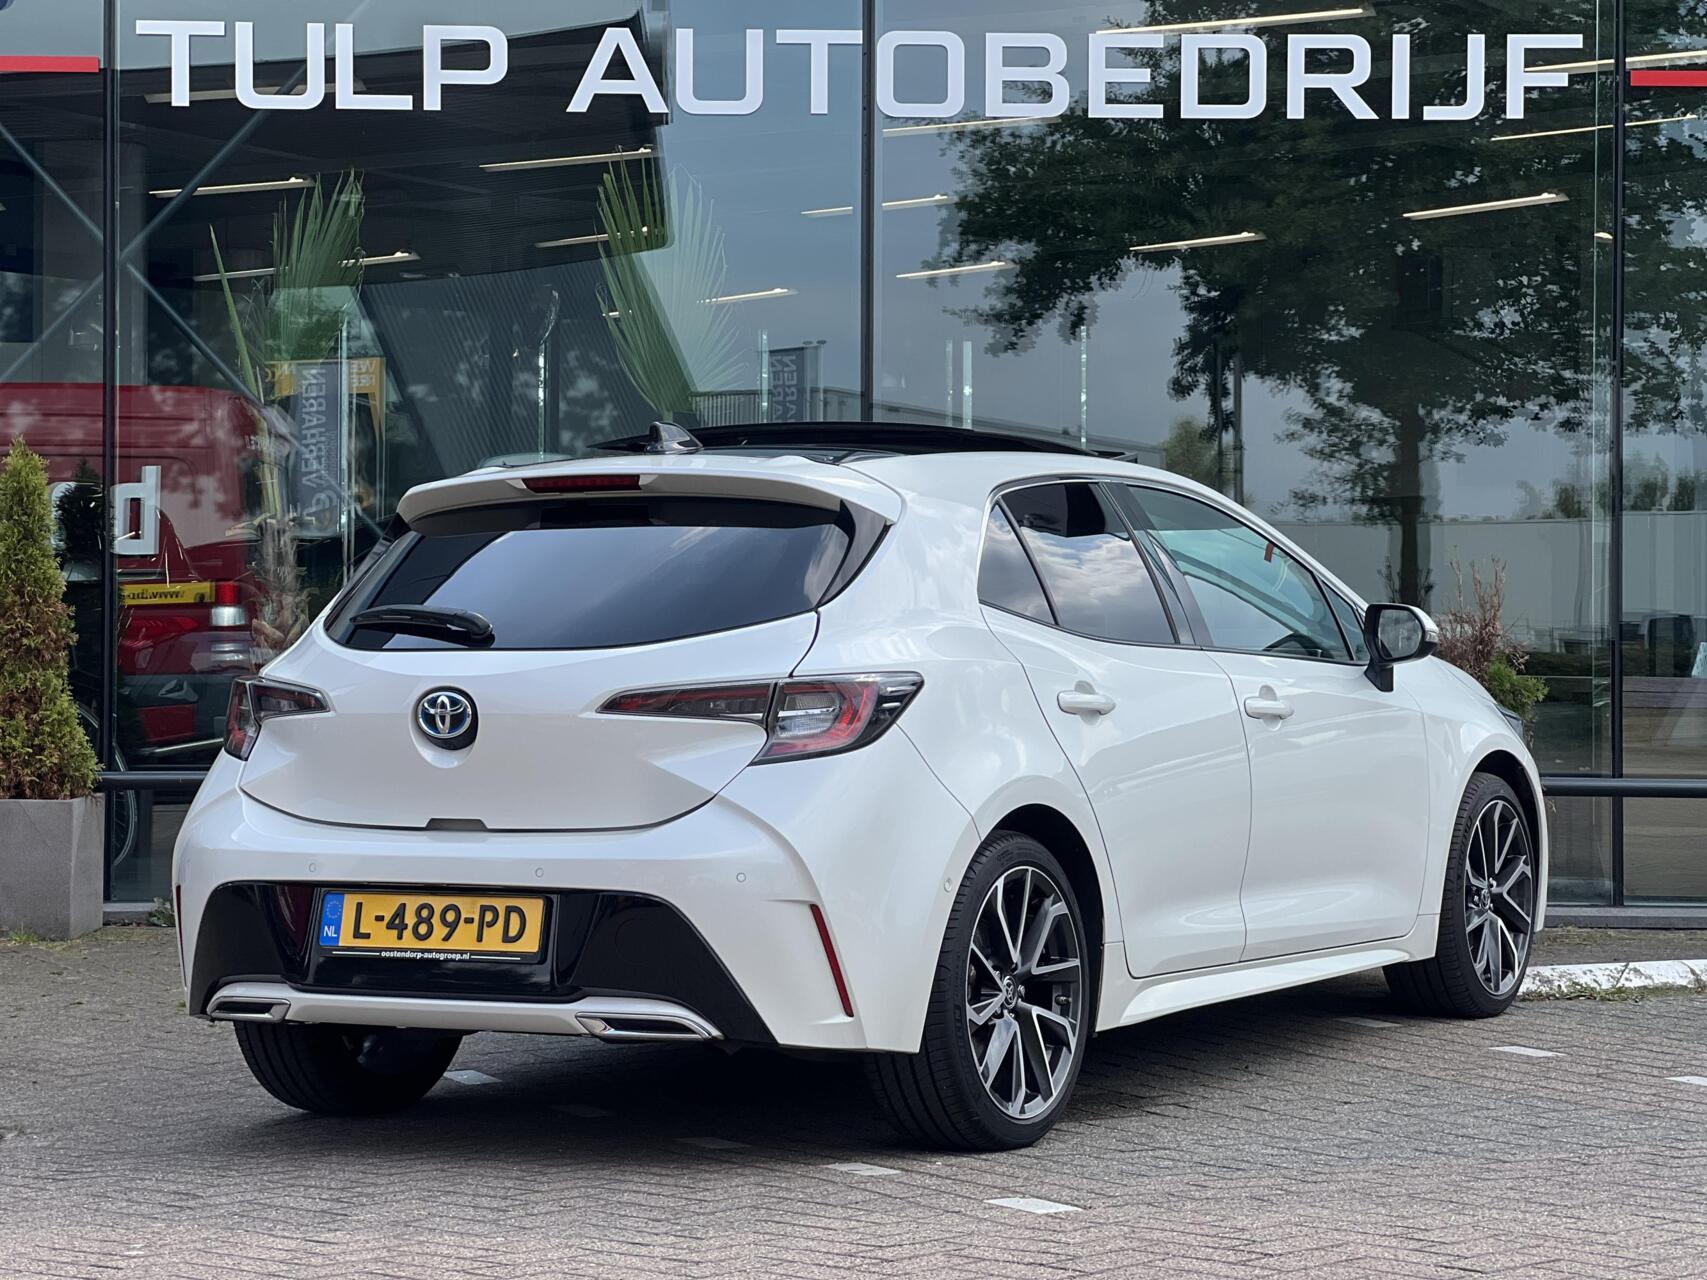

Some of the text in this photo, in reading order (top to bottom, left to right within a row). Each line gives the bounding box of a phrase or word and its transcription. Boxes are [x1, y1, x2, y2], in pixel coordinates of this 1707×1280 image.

[136, 20, 1583, 120] TULP AUTOBEDRIJF
[323, 925, 338, 938] NL
[352, 901, 527, 943] L-489-PD
[380, 949, 471, 961] oostendorp-autogroep.nl
